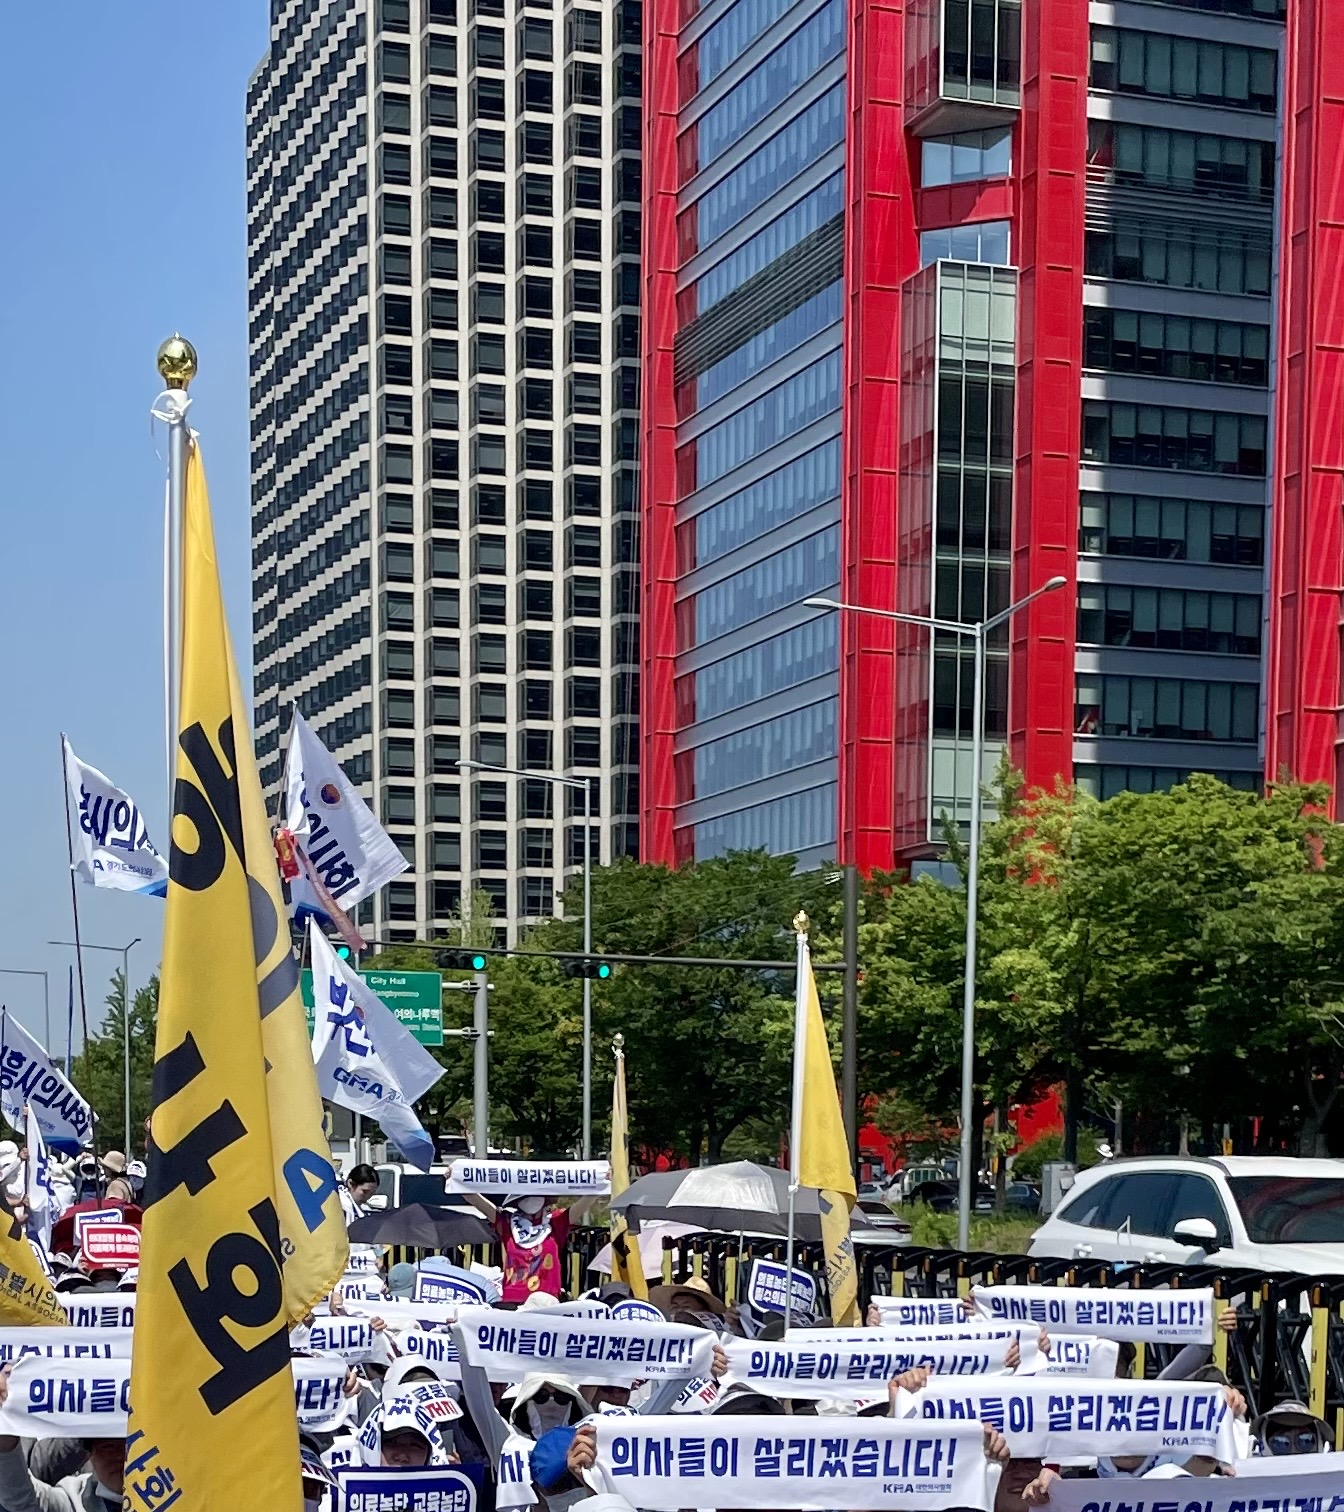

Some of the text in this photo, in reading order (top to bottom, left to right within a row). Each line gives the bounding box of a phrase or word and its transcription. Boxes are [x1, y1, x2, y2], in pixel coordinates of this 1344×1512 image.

[389, 977, 406, 985] Hall
[333, 1067, 383, 1099] GMA
[462, 1167, 597, 1185] 의사들이 살리겠습니다!
[991, 1297, 1205, 1326] 의사들이 살리겠습니다!
[310, 1324, 373, 1350] 습니다!
[407, 1335, 460, 1362] 의사들
[478, 1325, 695, 1365] 의사들이 살리겠습니다!
[747, 1350, 839, 1380] 의사들이
[1048, 1394, 1227, 1435] 살리겠습니다!
[611, 1437, 957, 1479] 의사들이 살리겠습니다!
[883, 1483, 914, 1494] KMA
